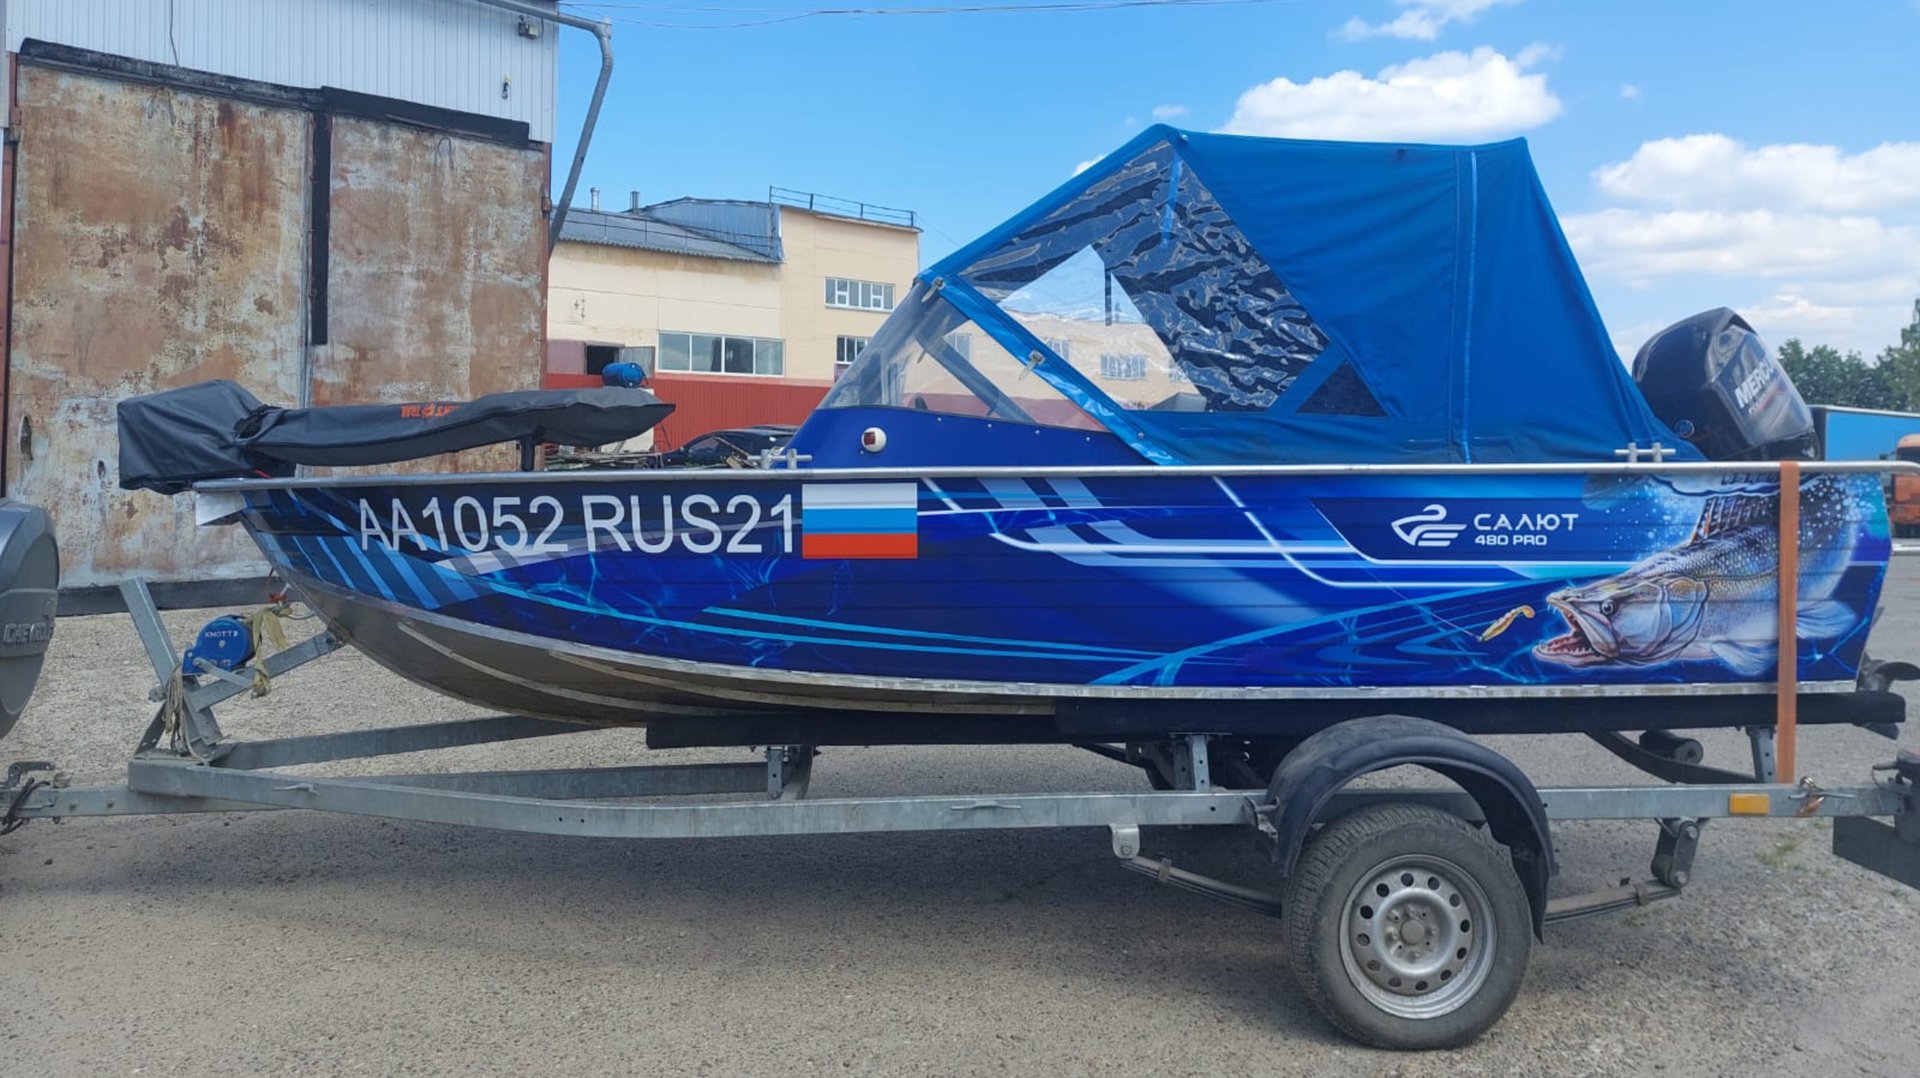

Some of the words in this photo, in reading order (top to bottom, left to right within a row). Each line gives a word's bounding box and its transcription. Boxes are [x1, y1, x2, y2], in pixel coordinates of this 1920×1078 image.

[359, 495, 569, 552] AA1052
[582, 494, 793, 554] RUS21
[1473, 513, 1579, 531] САЛЮТ
[1474, 534, 1509, 546] 480
[1513, 534, 1548, 546] PRO
